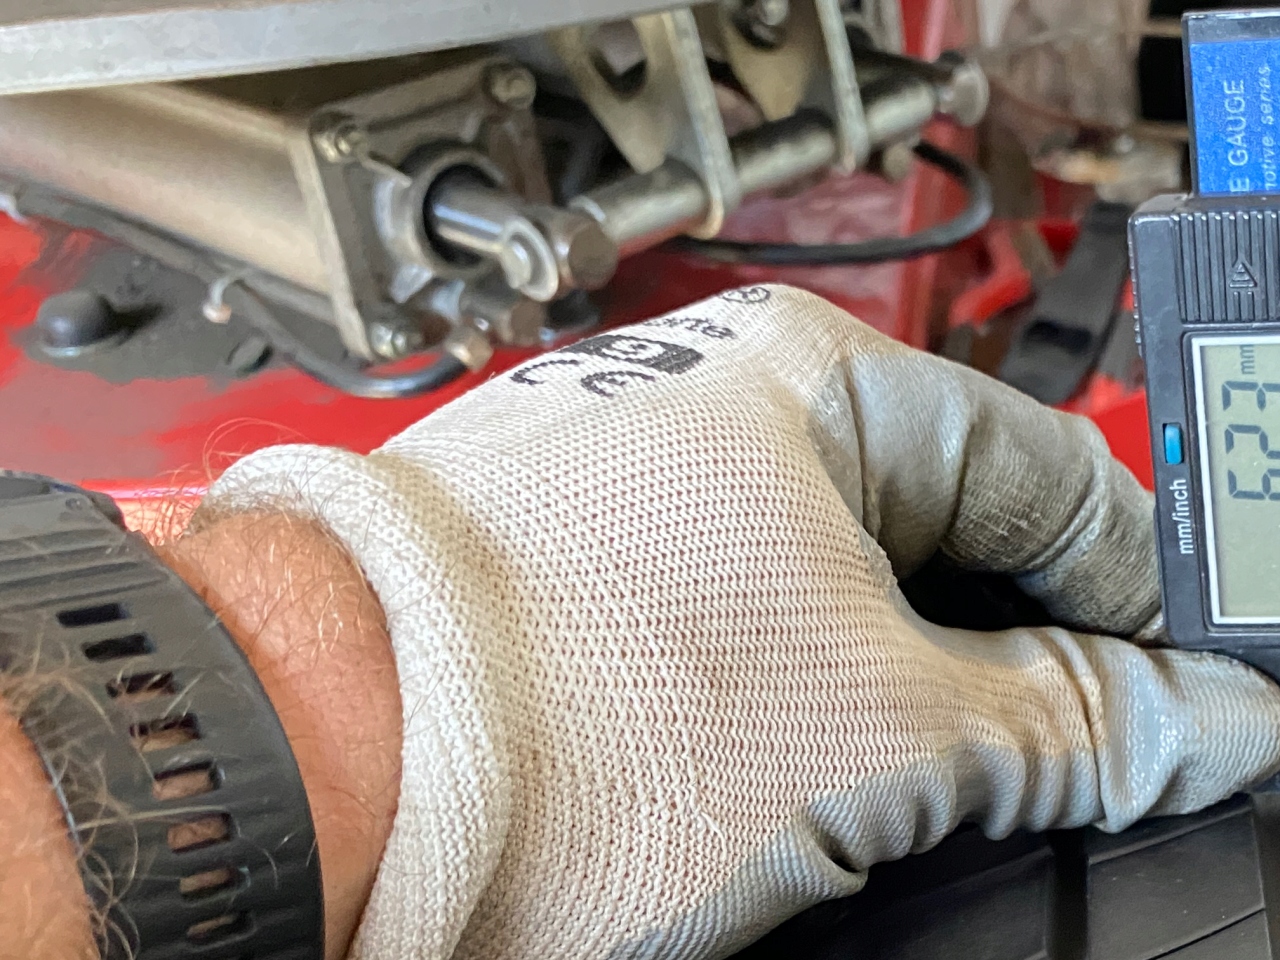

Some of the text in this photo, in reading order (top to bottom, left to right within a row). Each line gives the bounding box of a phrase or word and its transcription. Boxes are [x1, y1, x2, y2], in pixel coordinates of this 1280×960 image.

[1223, 78, 1249, 167] GAUGE
[1239, 344, 1256, 375] mm
[1170, 478, 1195, 555] mm/inch
